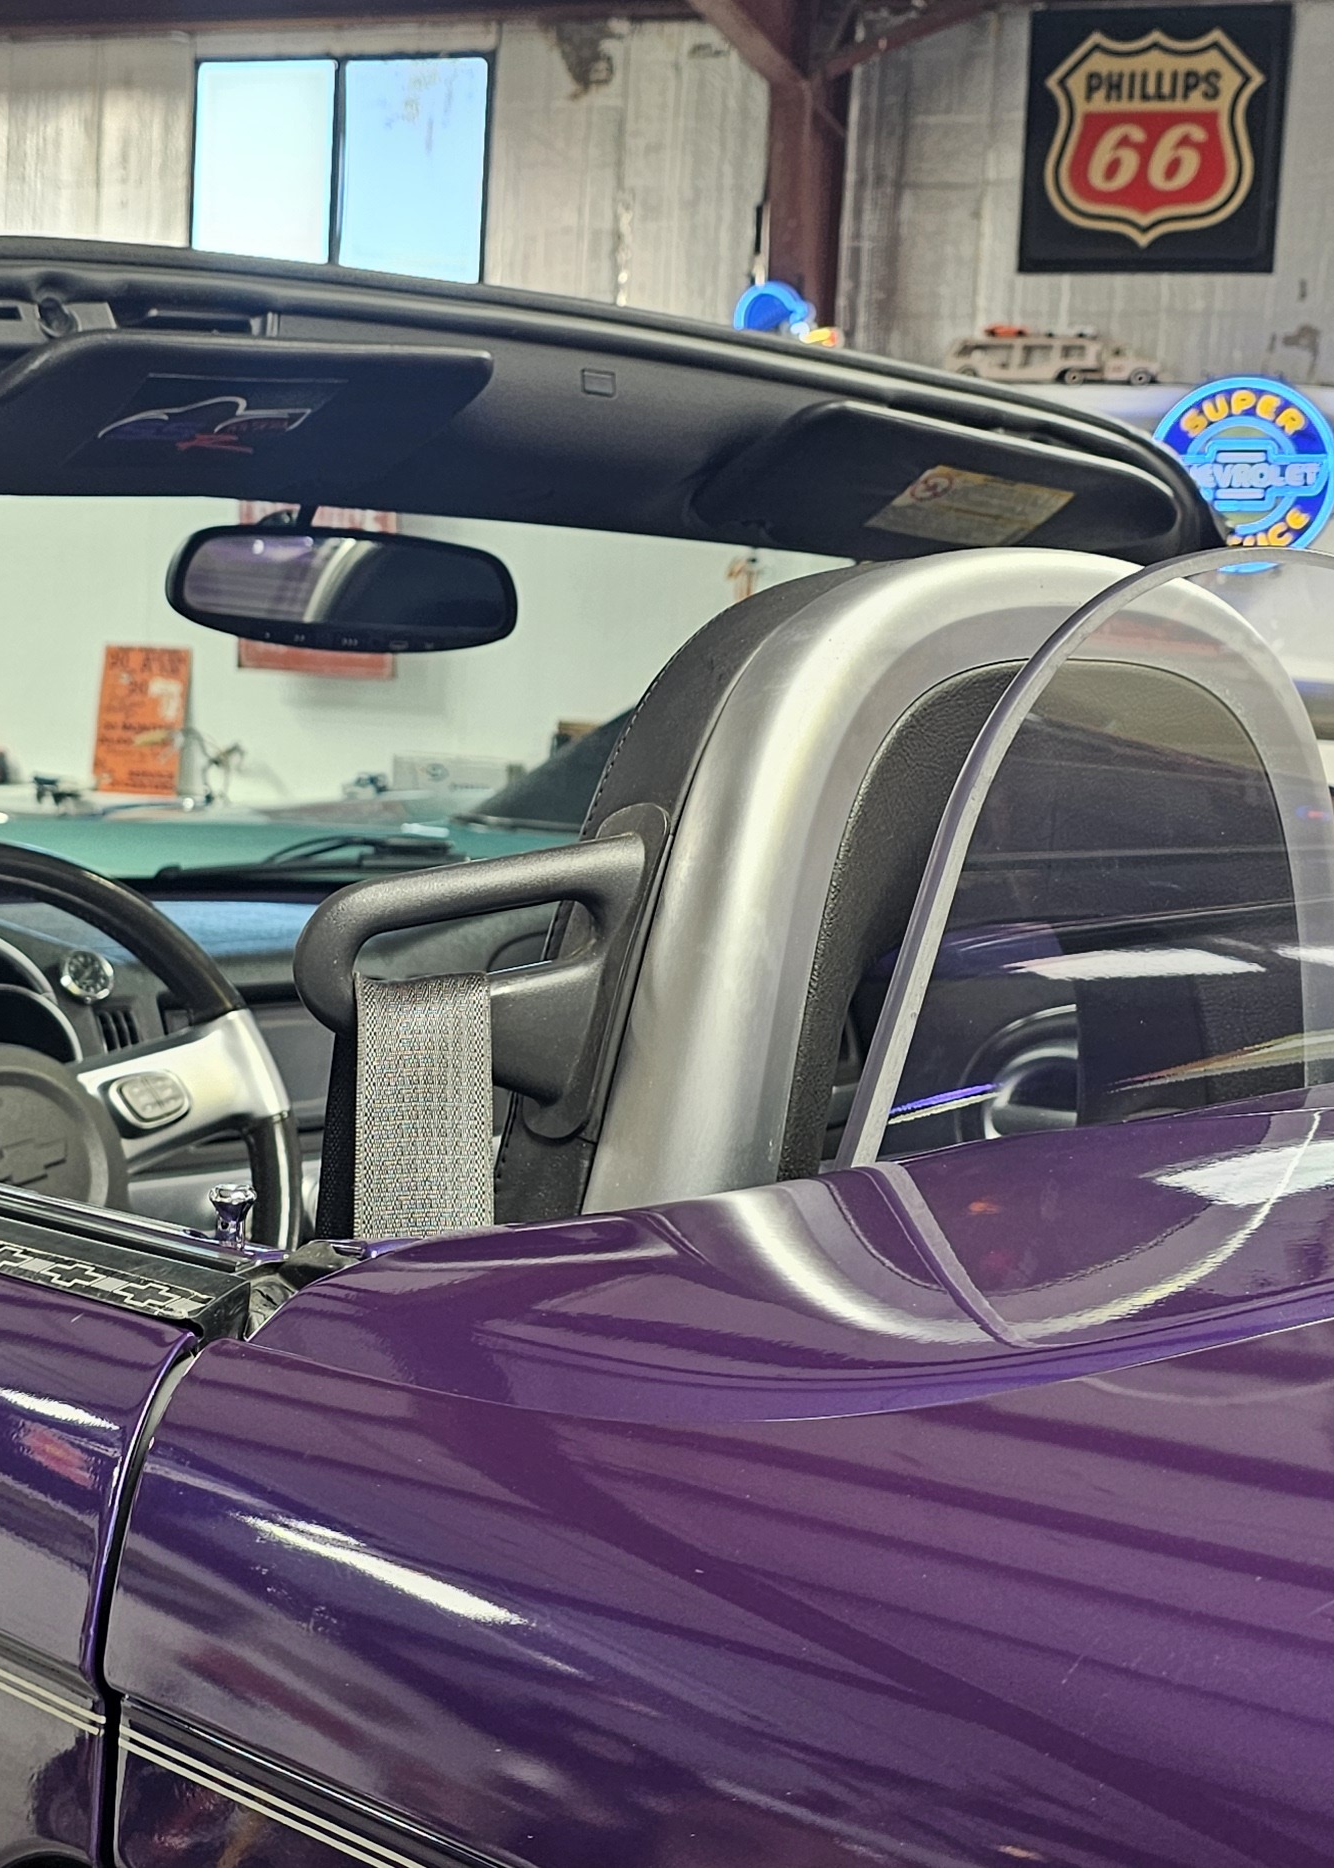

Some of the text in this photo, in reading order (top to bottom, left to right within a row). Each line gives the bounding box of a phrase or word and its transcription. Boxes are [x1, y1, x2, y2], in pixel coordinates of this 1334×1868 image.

[1084, 68, 1223, 102] PHILLIPS
[1086, 122, 1208, 193] 66
[1179, 389, 1307, 438] SUPER
